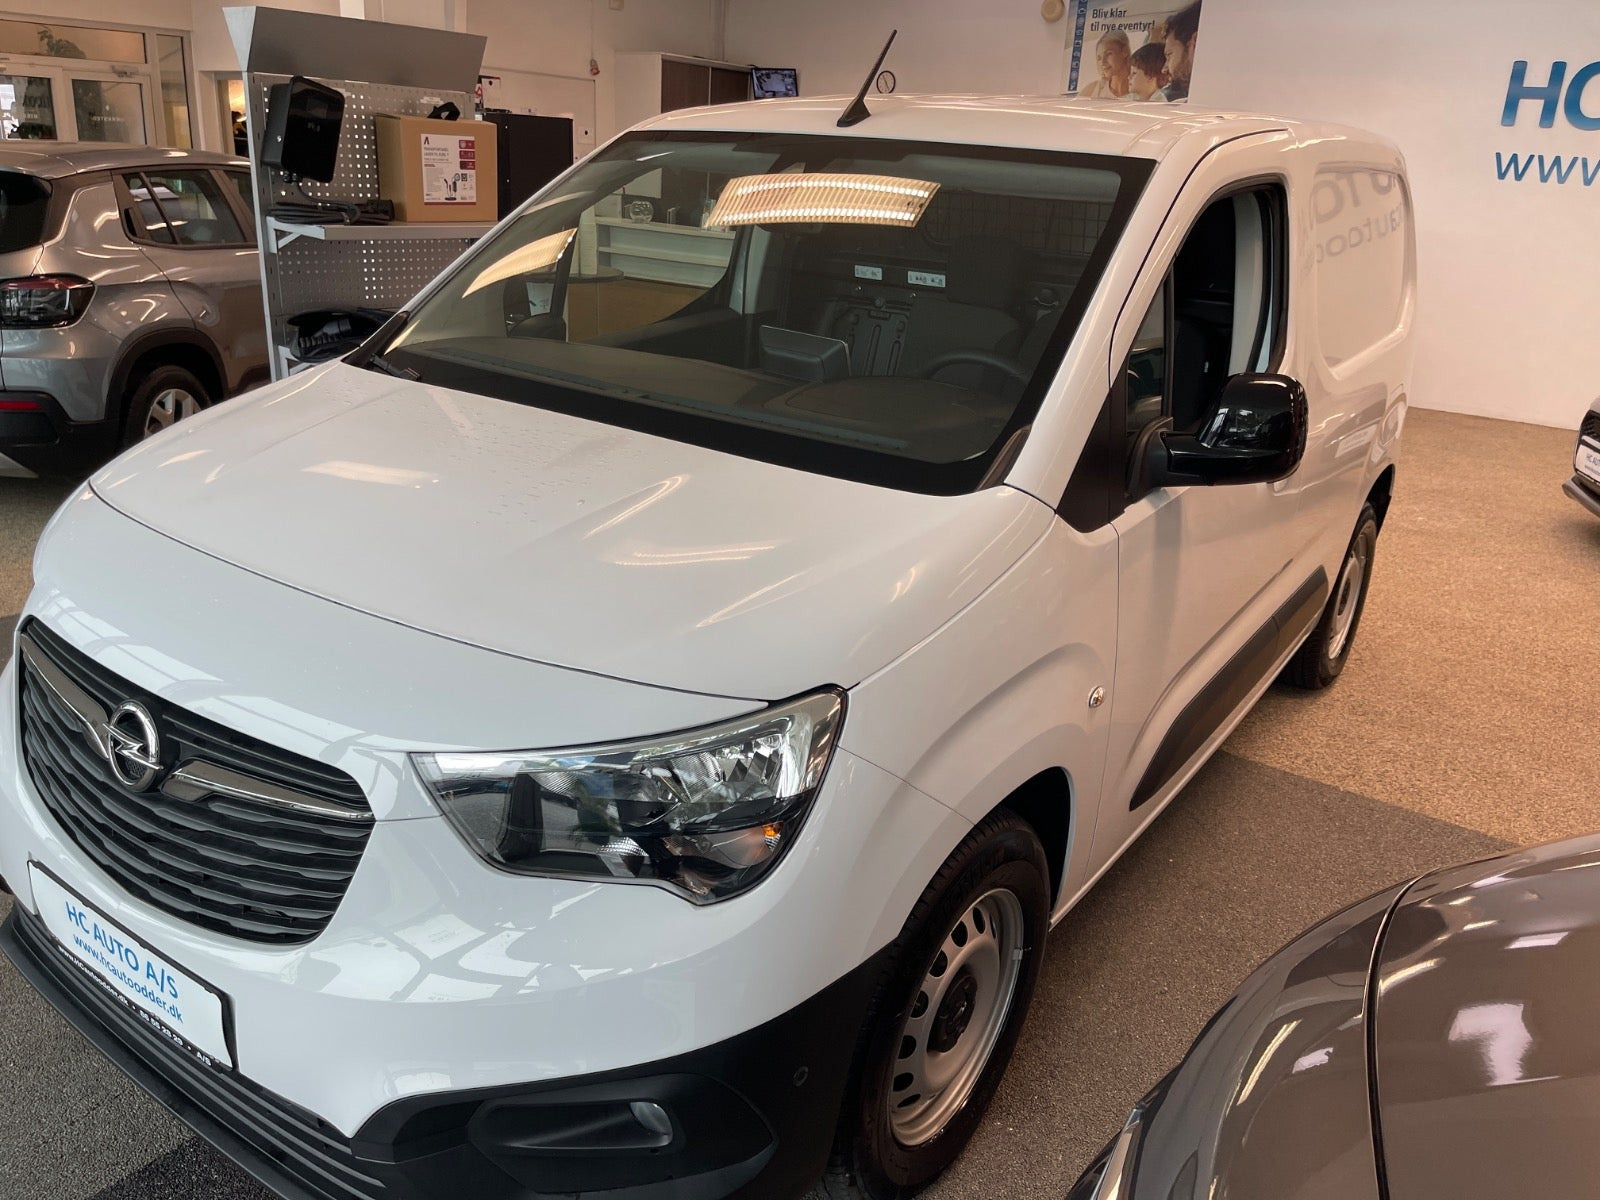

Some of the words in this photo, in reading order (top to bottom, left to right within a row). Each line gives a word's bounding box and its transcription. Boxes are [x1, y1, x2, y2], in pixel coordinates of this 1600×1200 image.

[1090, 22, 1100, 32] til
[1101, 22, 1116, 33] nye
[1118, 20, 1156, 32] eventyr!
[1092, 8, 1109, 19] Bliv
[1110, 7, 1127, 18] klar
[65, 901, 90, 934] HC
[93, 922, 139, 972] AUTO
[146, 960, 179, 999] A/S
[73, 934, 184, 1024] www.hcautoodder.dk
